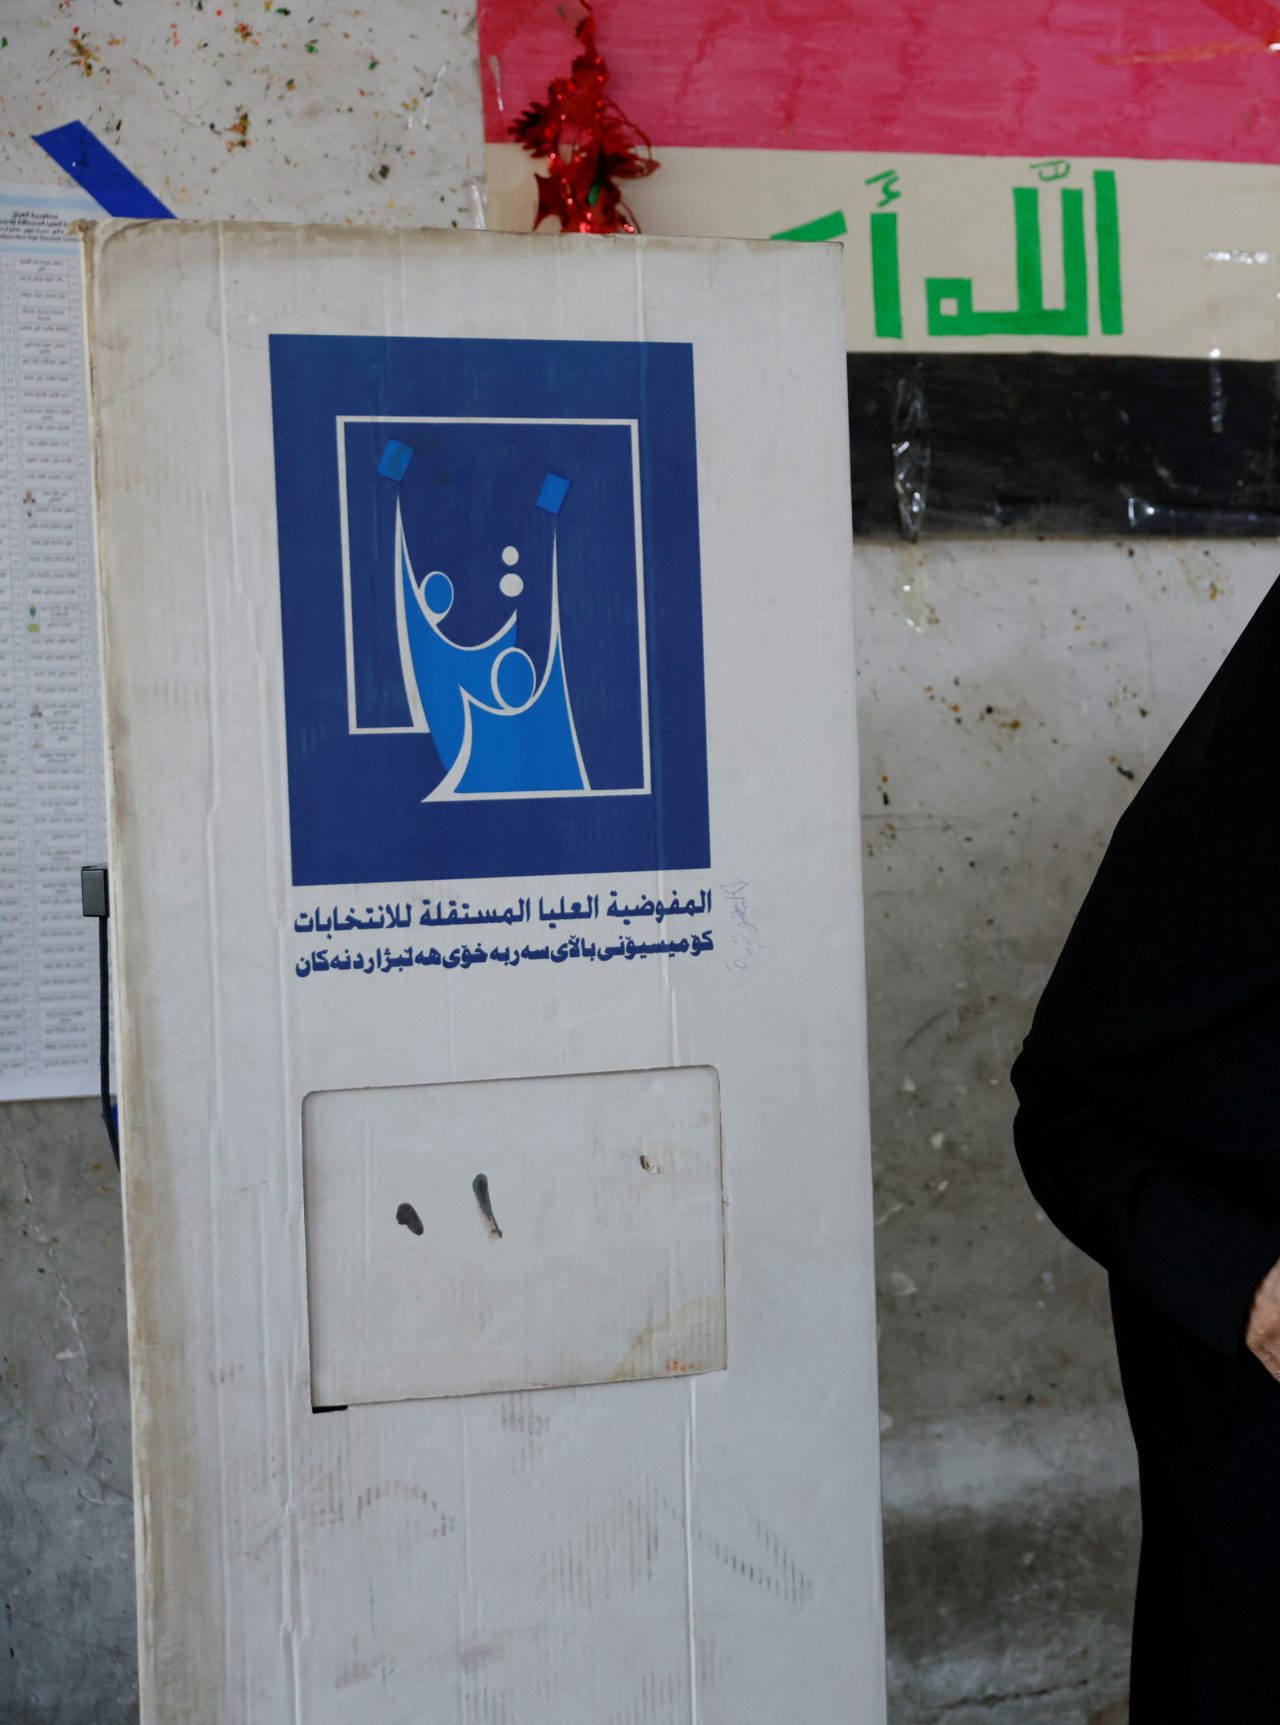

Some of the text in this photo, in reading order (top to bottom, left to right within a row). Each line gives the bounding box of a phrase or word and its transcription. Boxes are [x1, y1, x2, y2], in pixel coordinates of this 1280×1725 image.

[293, 888, 713, 940] المفوضية العليا المستقلة للانتخابات
